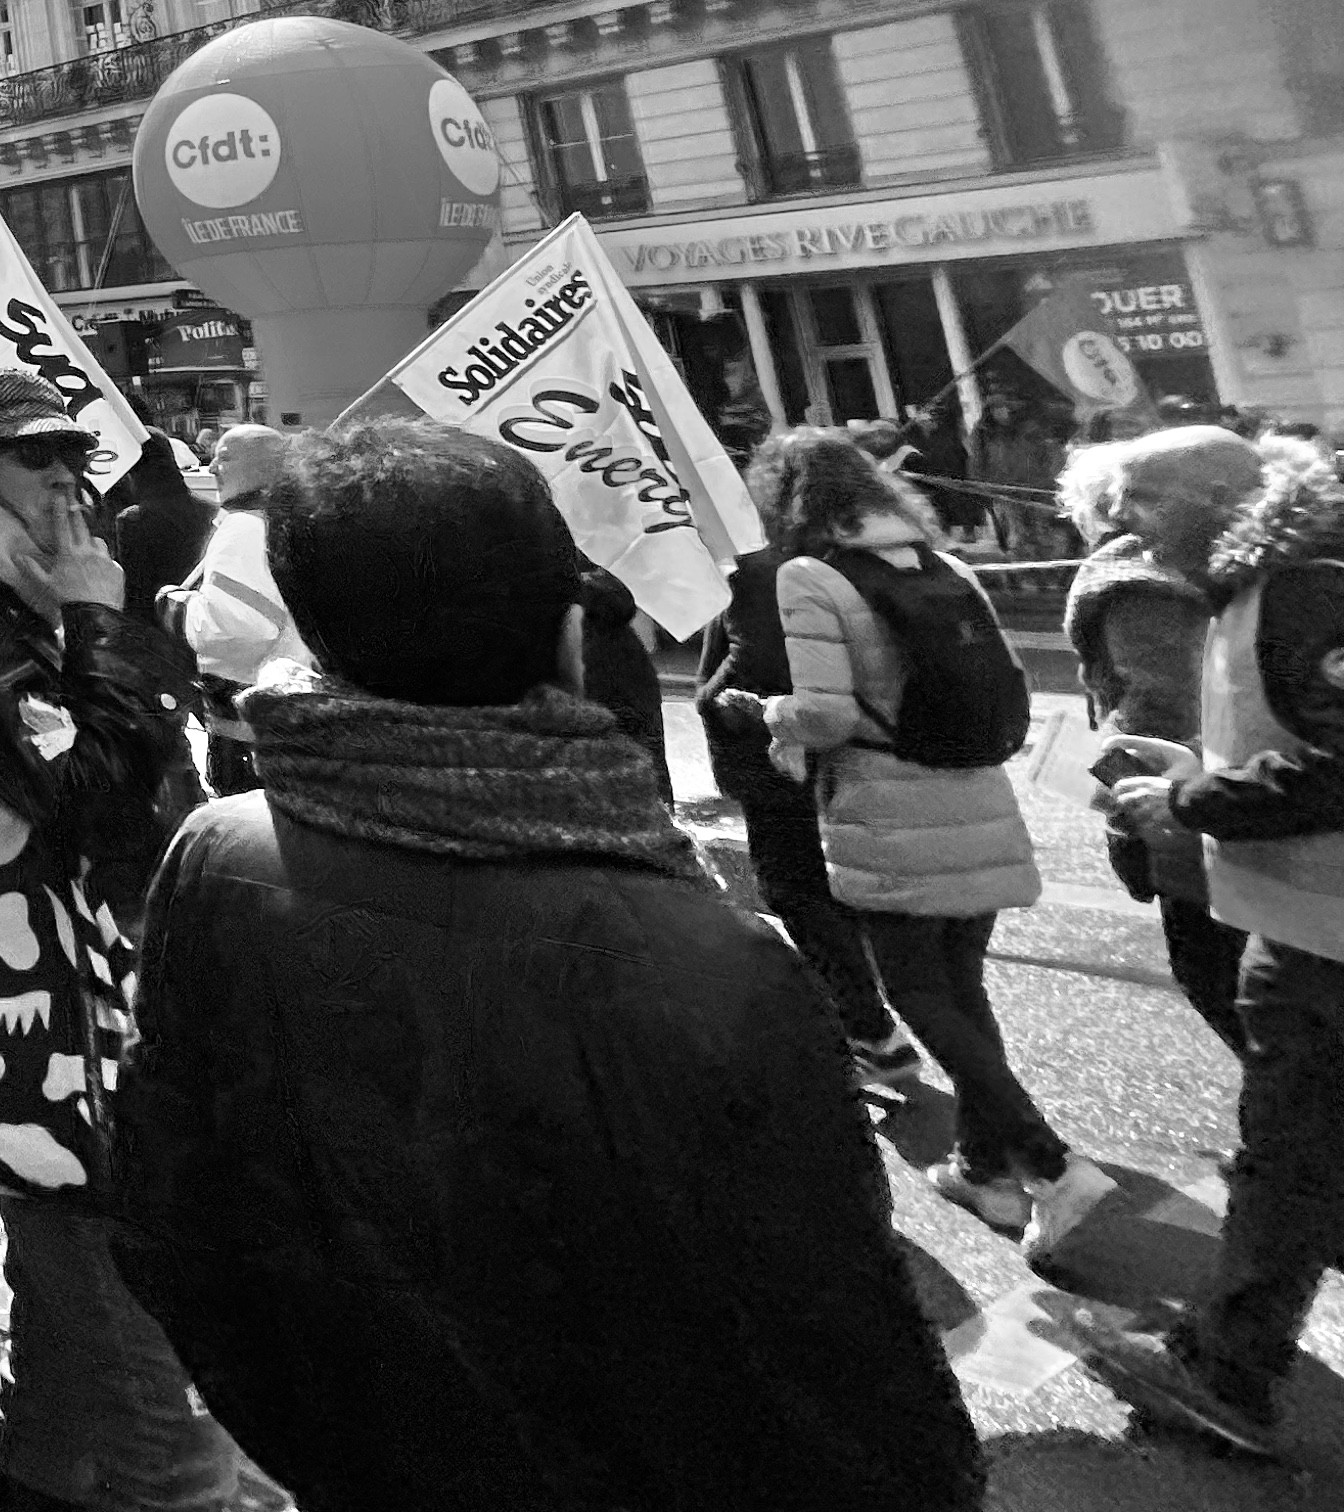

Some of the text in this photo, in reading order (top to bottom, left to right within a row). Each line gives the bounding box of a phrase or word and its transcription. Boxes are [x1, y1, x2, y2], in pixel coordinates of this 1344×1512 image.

[620, 198, 1096, 273] VOYAGES RIVE GAUCHE
[525, 264, 555, 288] Union
[437, 270, 593, 406] Solidaires
